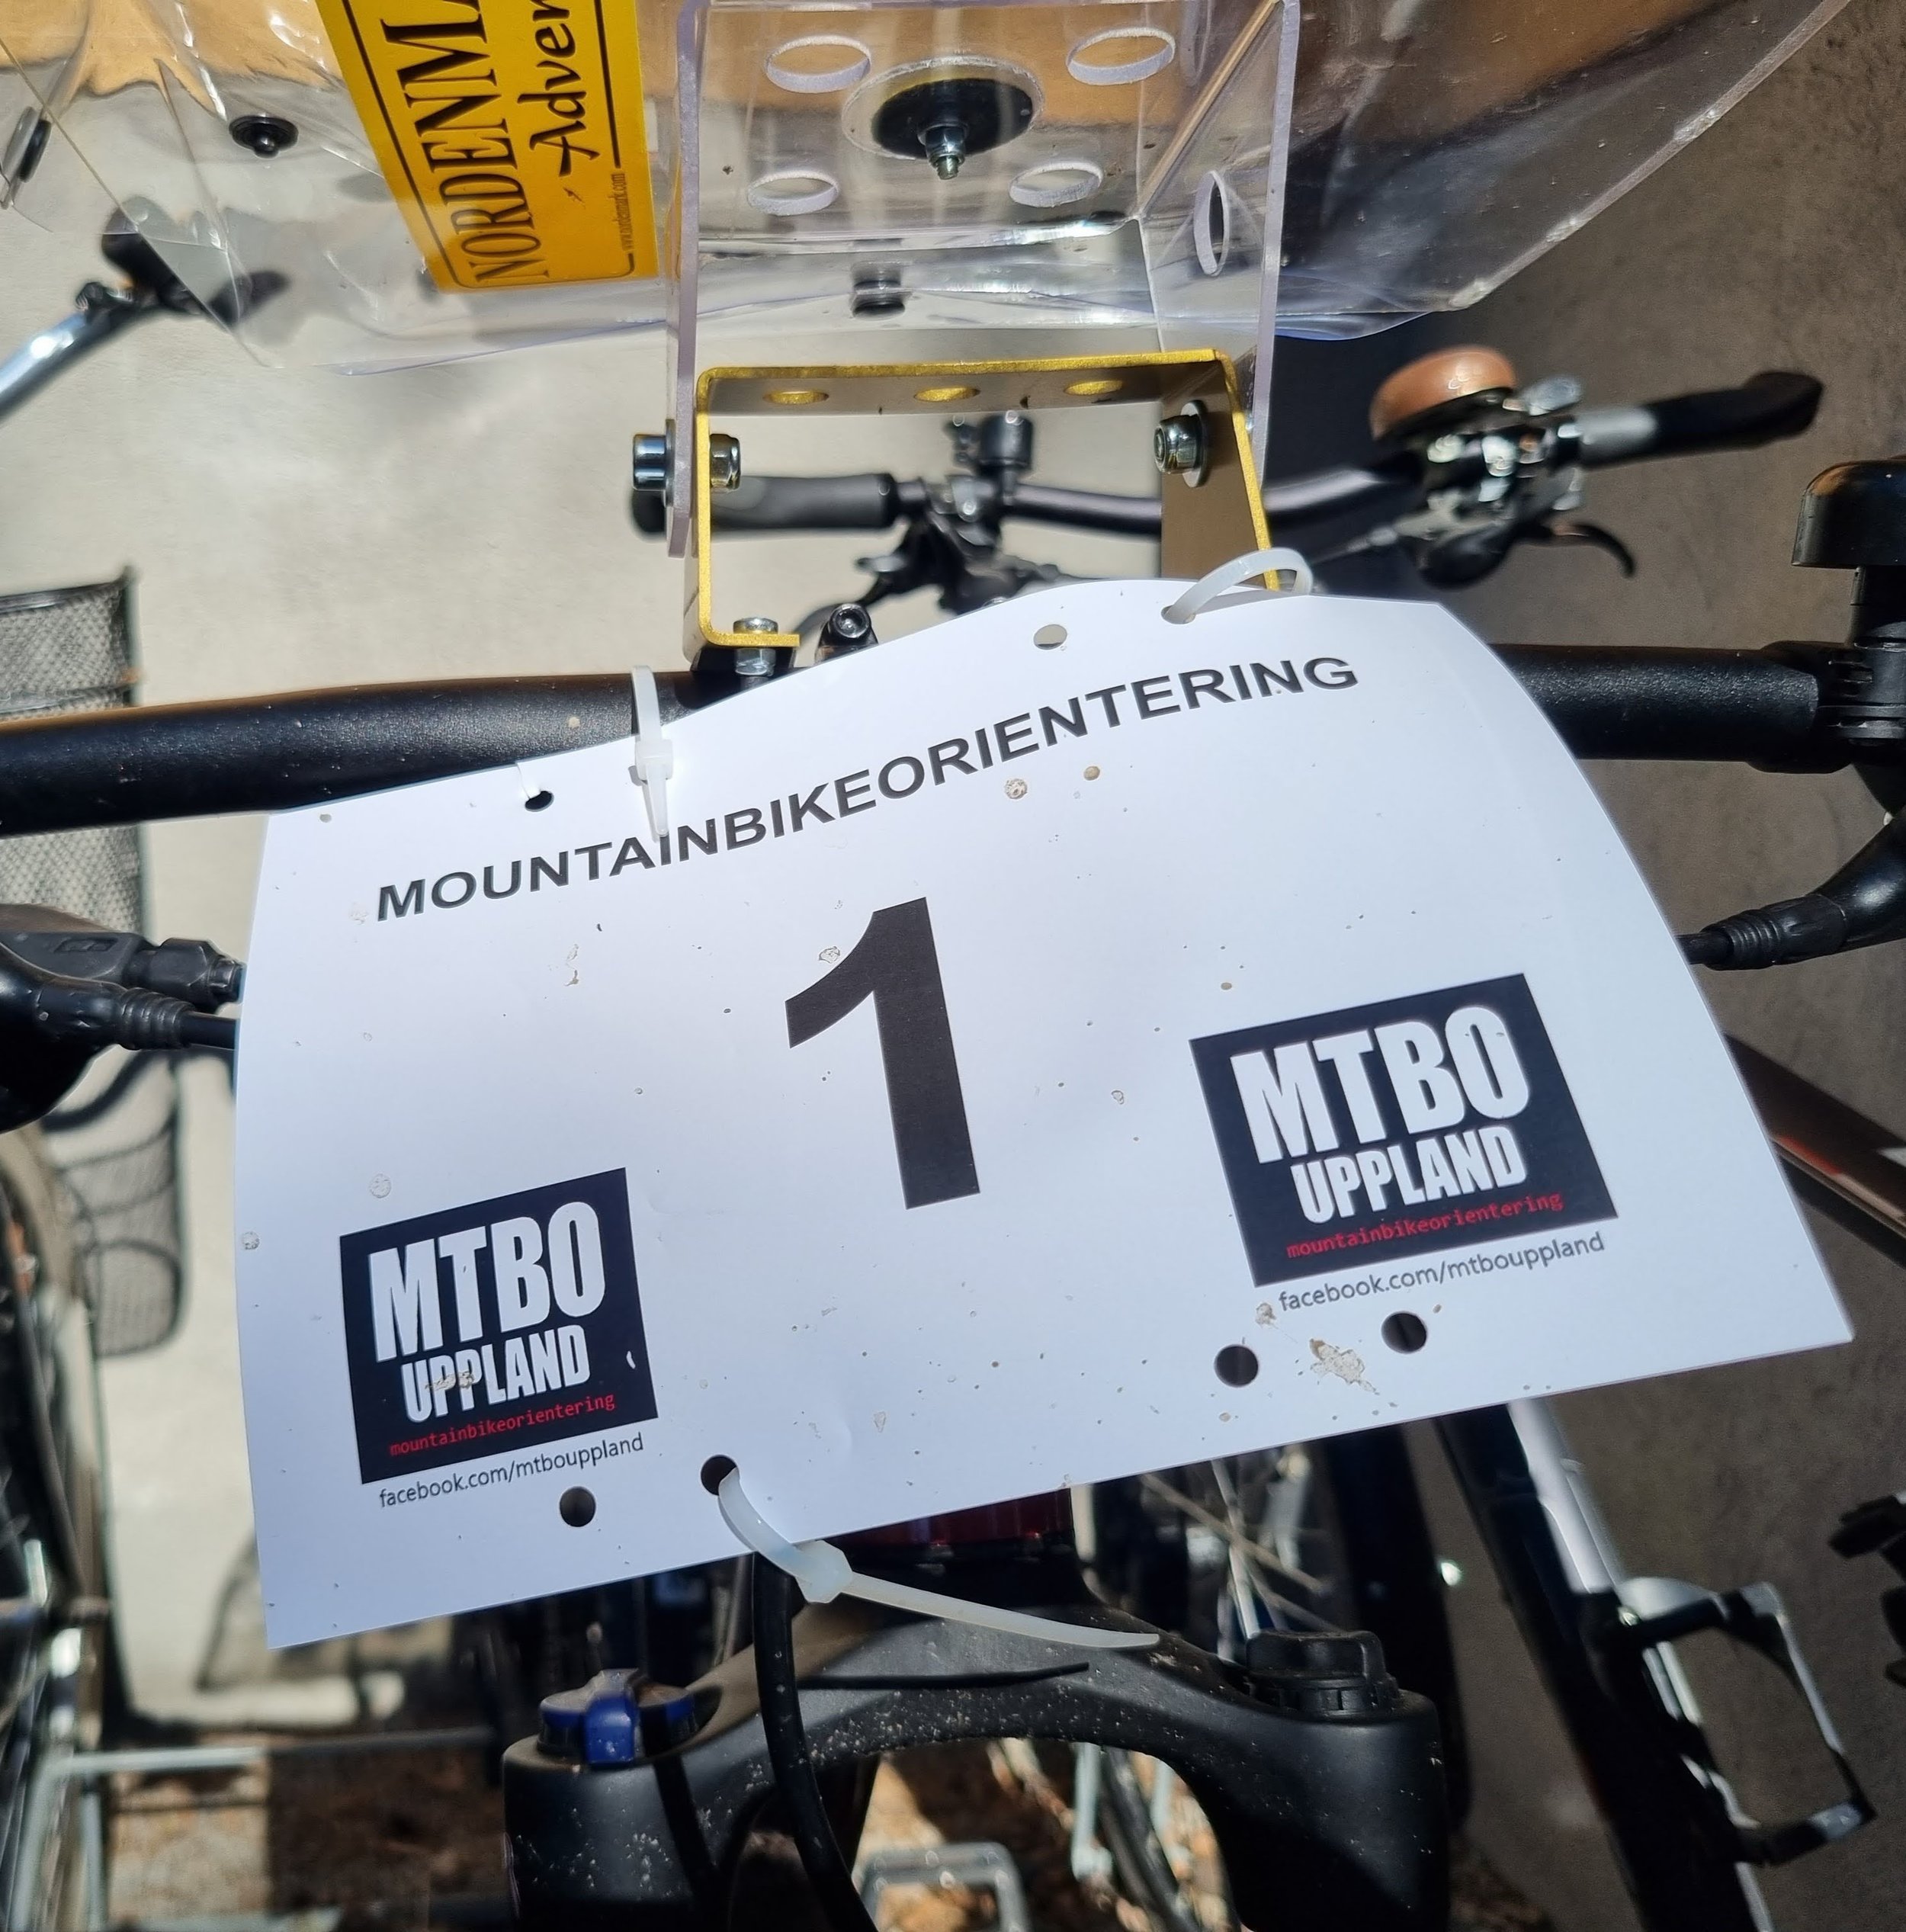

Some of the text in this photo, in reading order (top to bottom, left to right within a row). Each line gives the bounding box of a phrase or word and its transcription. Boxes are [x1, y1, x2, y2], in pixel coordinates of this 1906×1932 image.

[380, 0, 550, 282] NORDENM
[376, 656, 1358, 921] MOUNTAINBIKEORIENTERING
[785, 897, 980, 1210] 1
[1230, 1005, 1529, 1165] MTBO
[1290, 1125, 1527, 1224] UPPLAND
[1279, 1231, 1605, 1311] facebook.com/mtbouppland
[1286, 1191, 1564, 1260] mountainbikeorientering
[368, 1201, 605, 1363] MTBO
[400, 1324, 591, 1423] UPPLAND
[379, 1431, 644, 1507] facebook.com/mtbouppland
[390, 1392, 616, 1456] mountainbikeorientering
